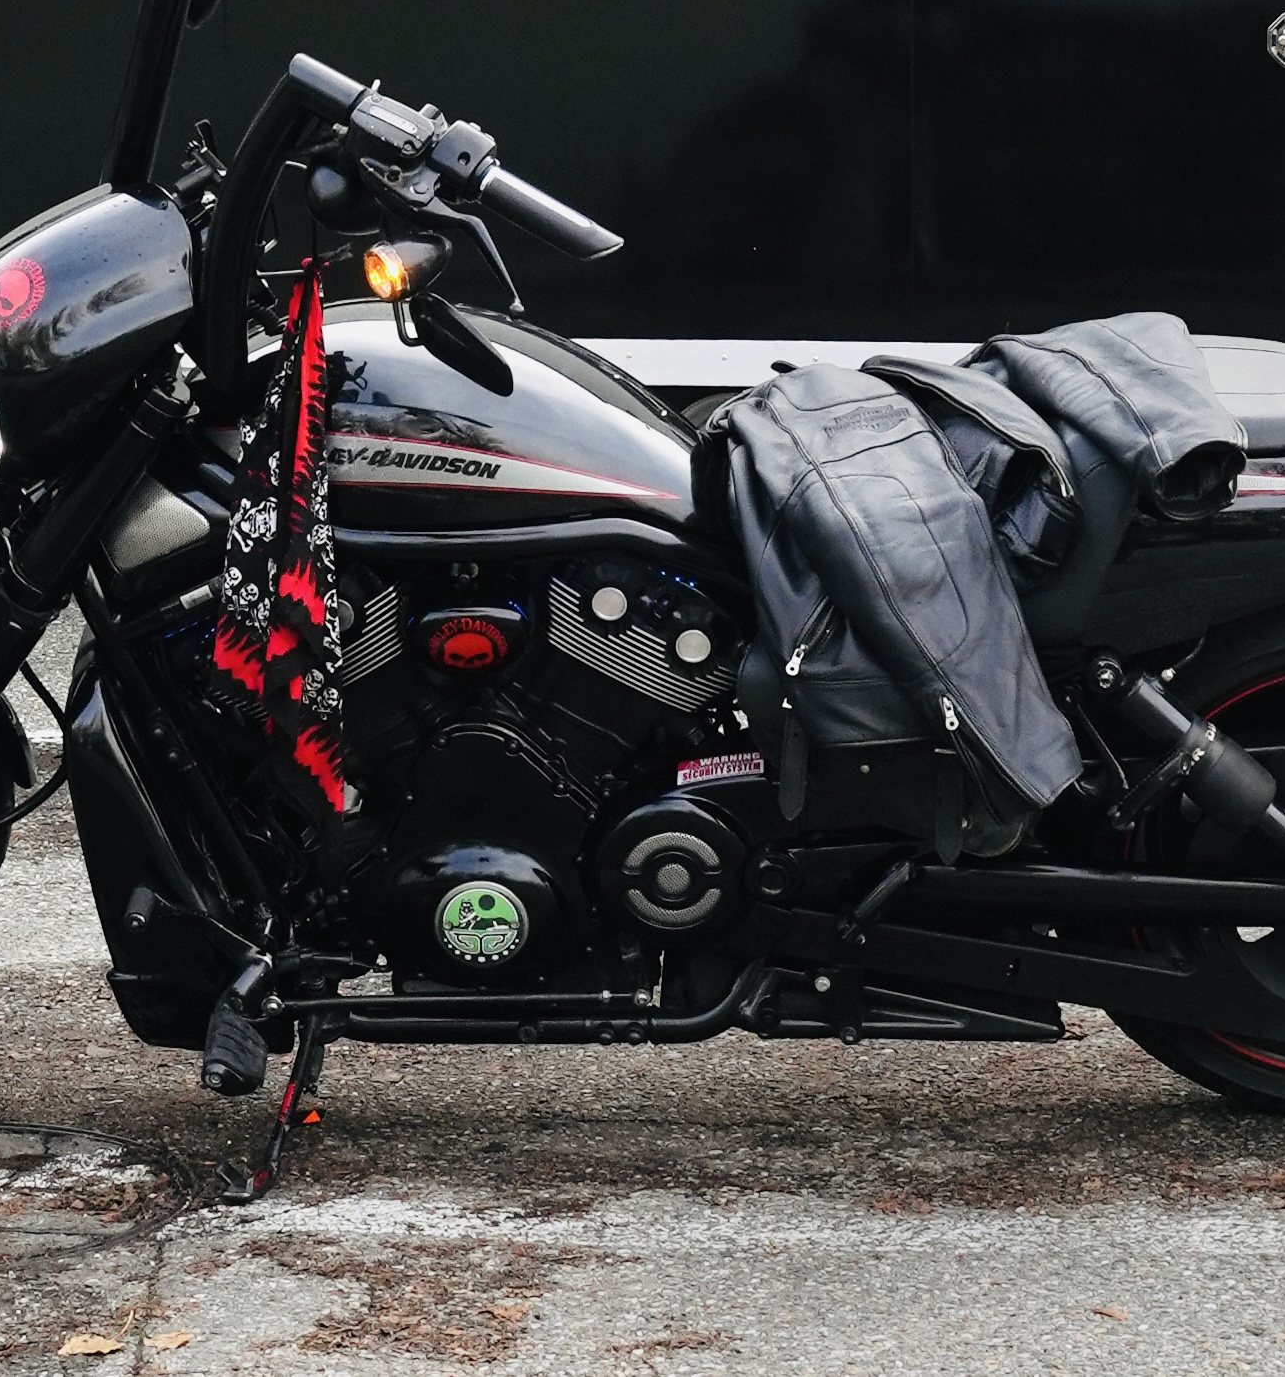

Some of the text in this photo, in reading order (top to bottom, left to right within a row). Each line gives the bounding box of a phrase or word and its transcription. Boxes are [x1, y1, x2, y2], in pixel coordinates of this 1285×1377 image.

[326, 446, 501, 479] EY-DAVIDSON
[682, 759, 761, 781] SECURITY SYSTEM
[700, 752, 760, 766] WARNING
